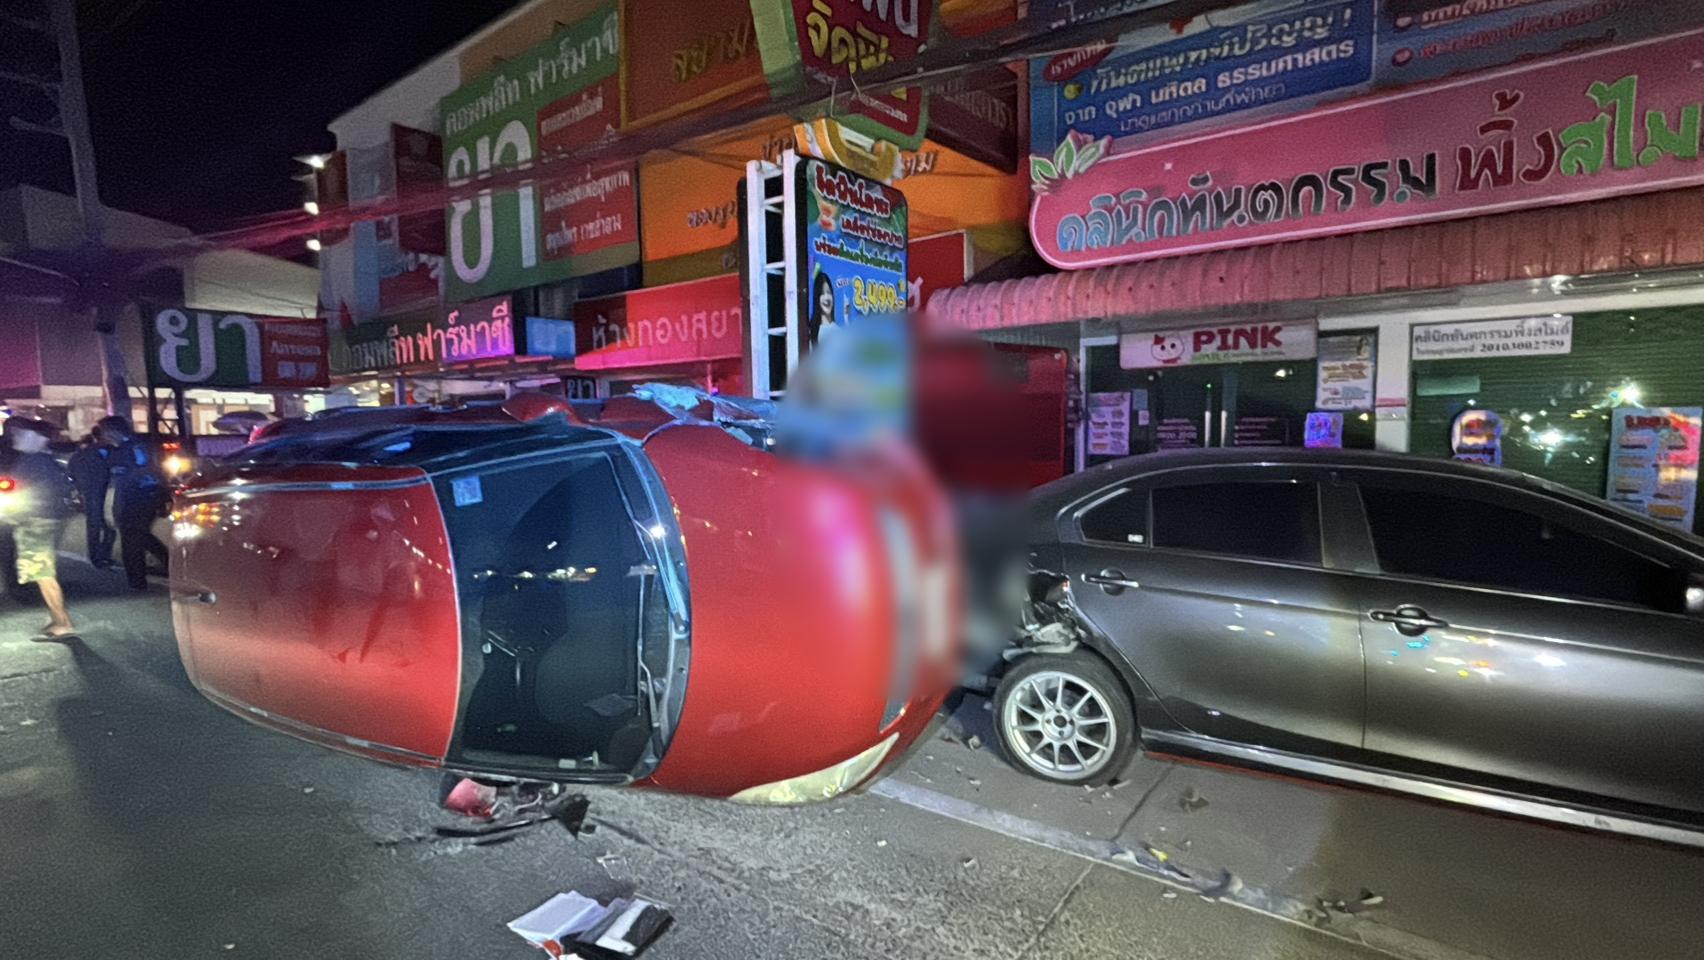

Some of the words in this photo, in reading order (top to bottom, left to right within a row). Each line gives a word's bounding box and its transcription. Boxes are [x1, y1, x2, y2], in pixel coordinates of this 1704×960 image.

[1151, 77, 1207, 103] มหิดล
[448, 120, 537, 283] ยา
[156, 309, 262, 384] ยา
[1193, 325, 1283, 352] PINK
